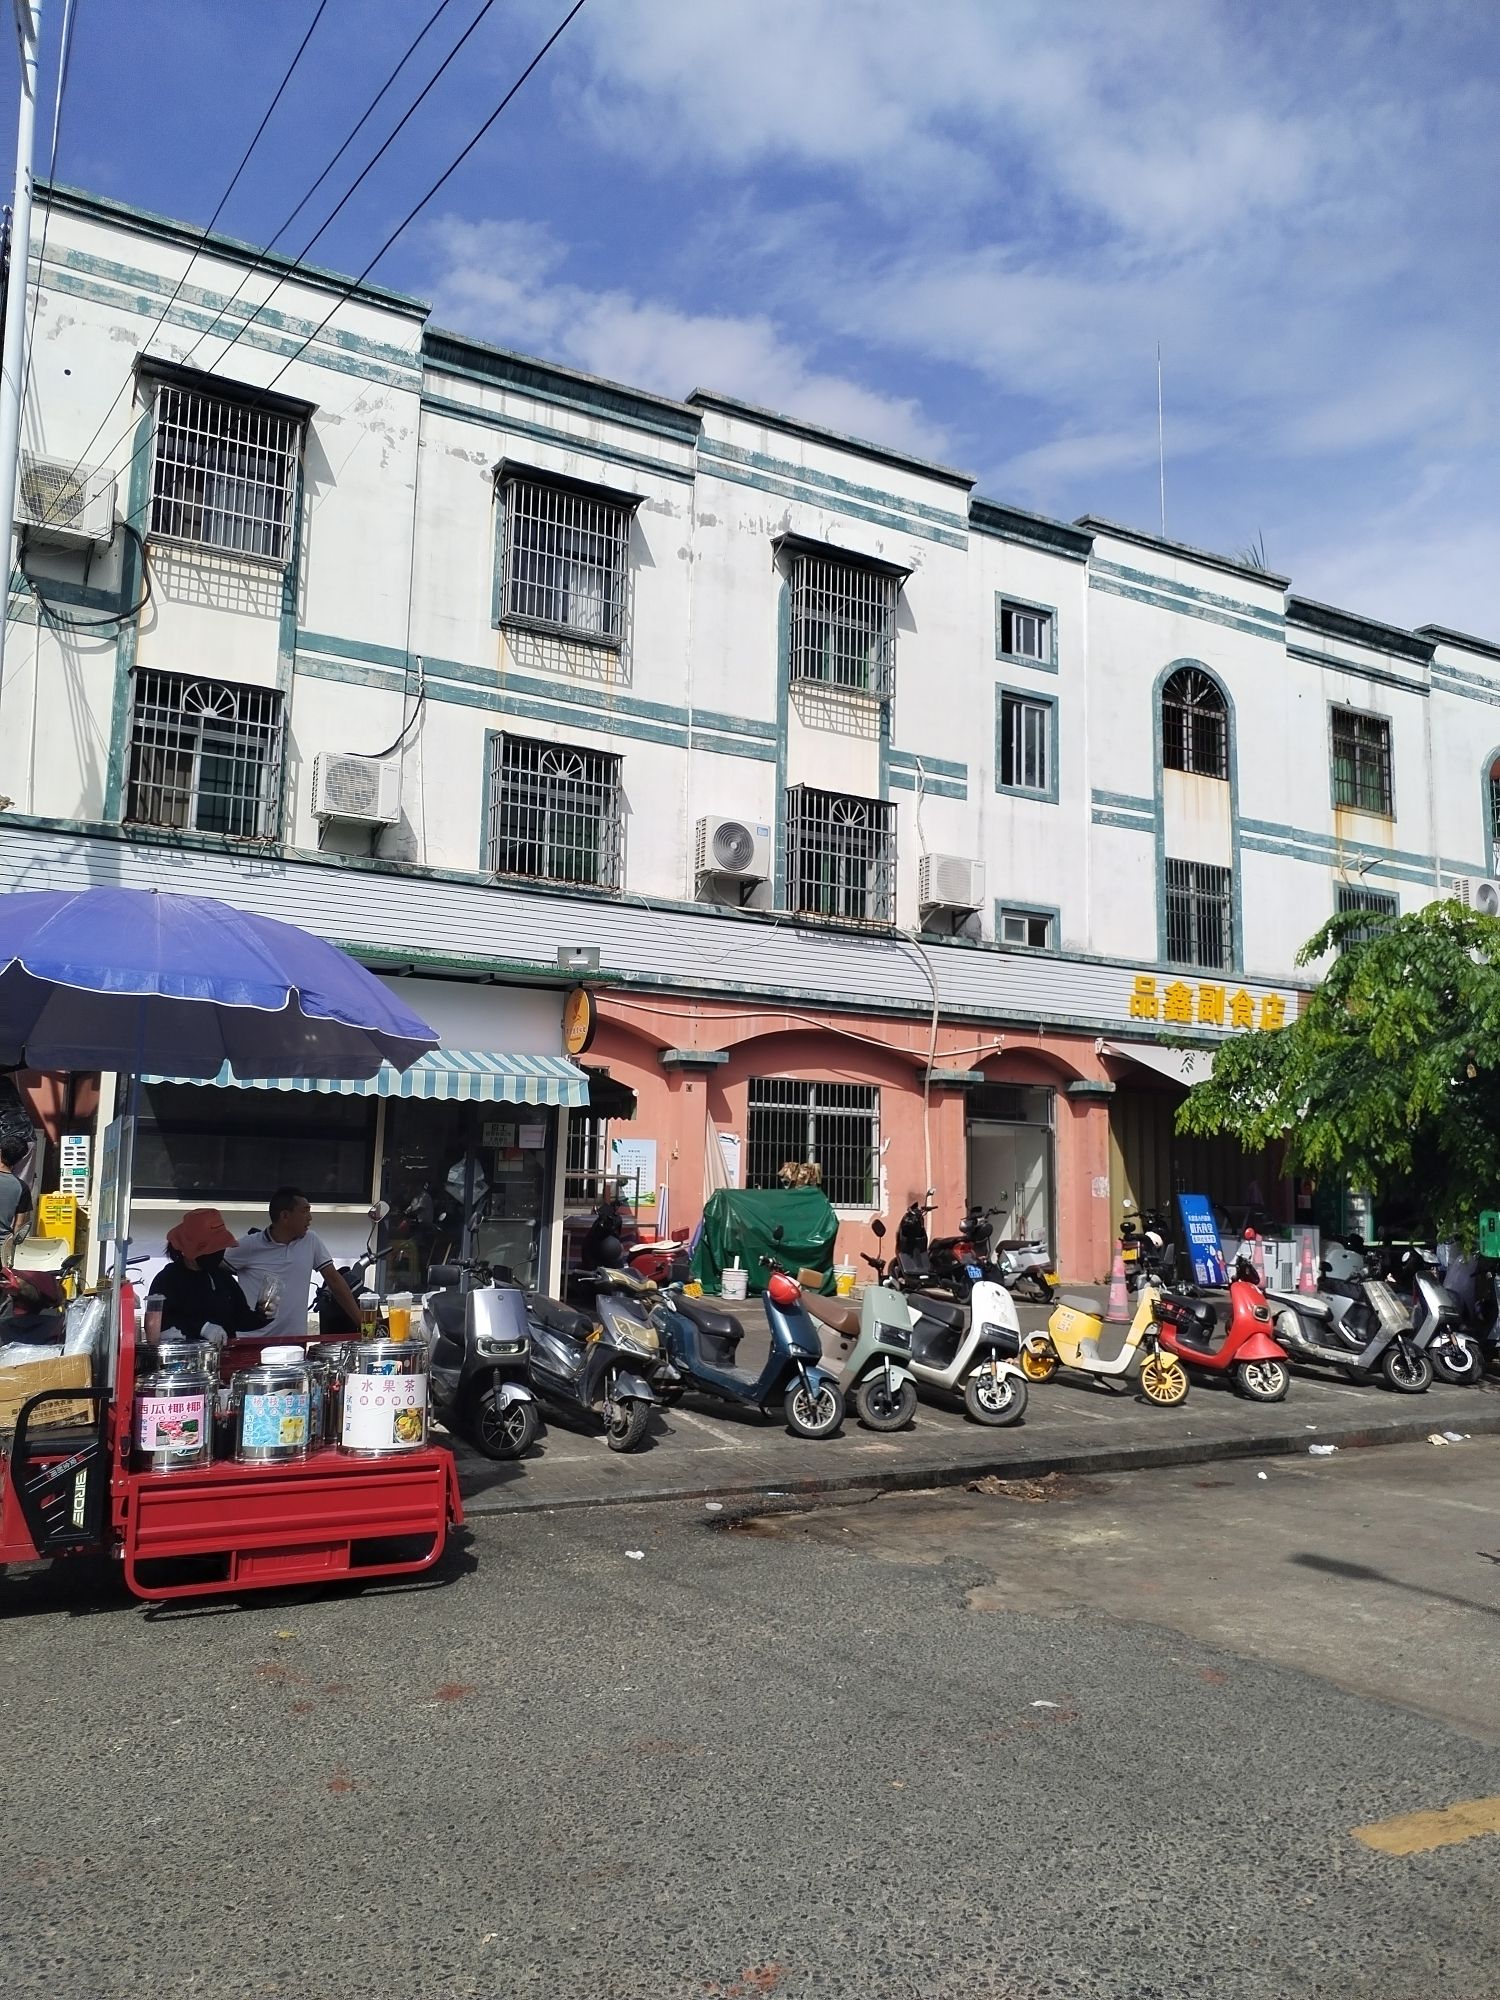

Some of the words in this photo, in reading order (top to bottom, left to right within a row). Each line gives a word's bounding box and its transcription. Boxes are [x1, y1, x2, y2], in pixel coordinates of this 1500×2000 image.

[1130, 975, 1286, 1031] 品鑫副食店
[361, 1379, 416, 1393] 水果茶
[140, 1401, 202, 1415] 西瓜椰椰
[252, 1395, 307, 1408] 杨枝甘露
[72, 1468, 88, 1528] BIRDIE
